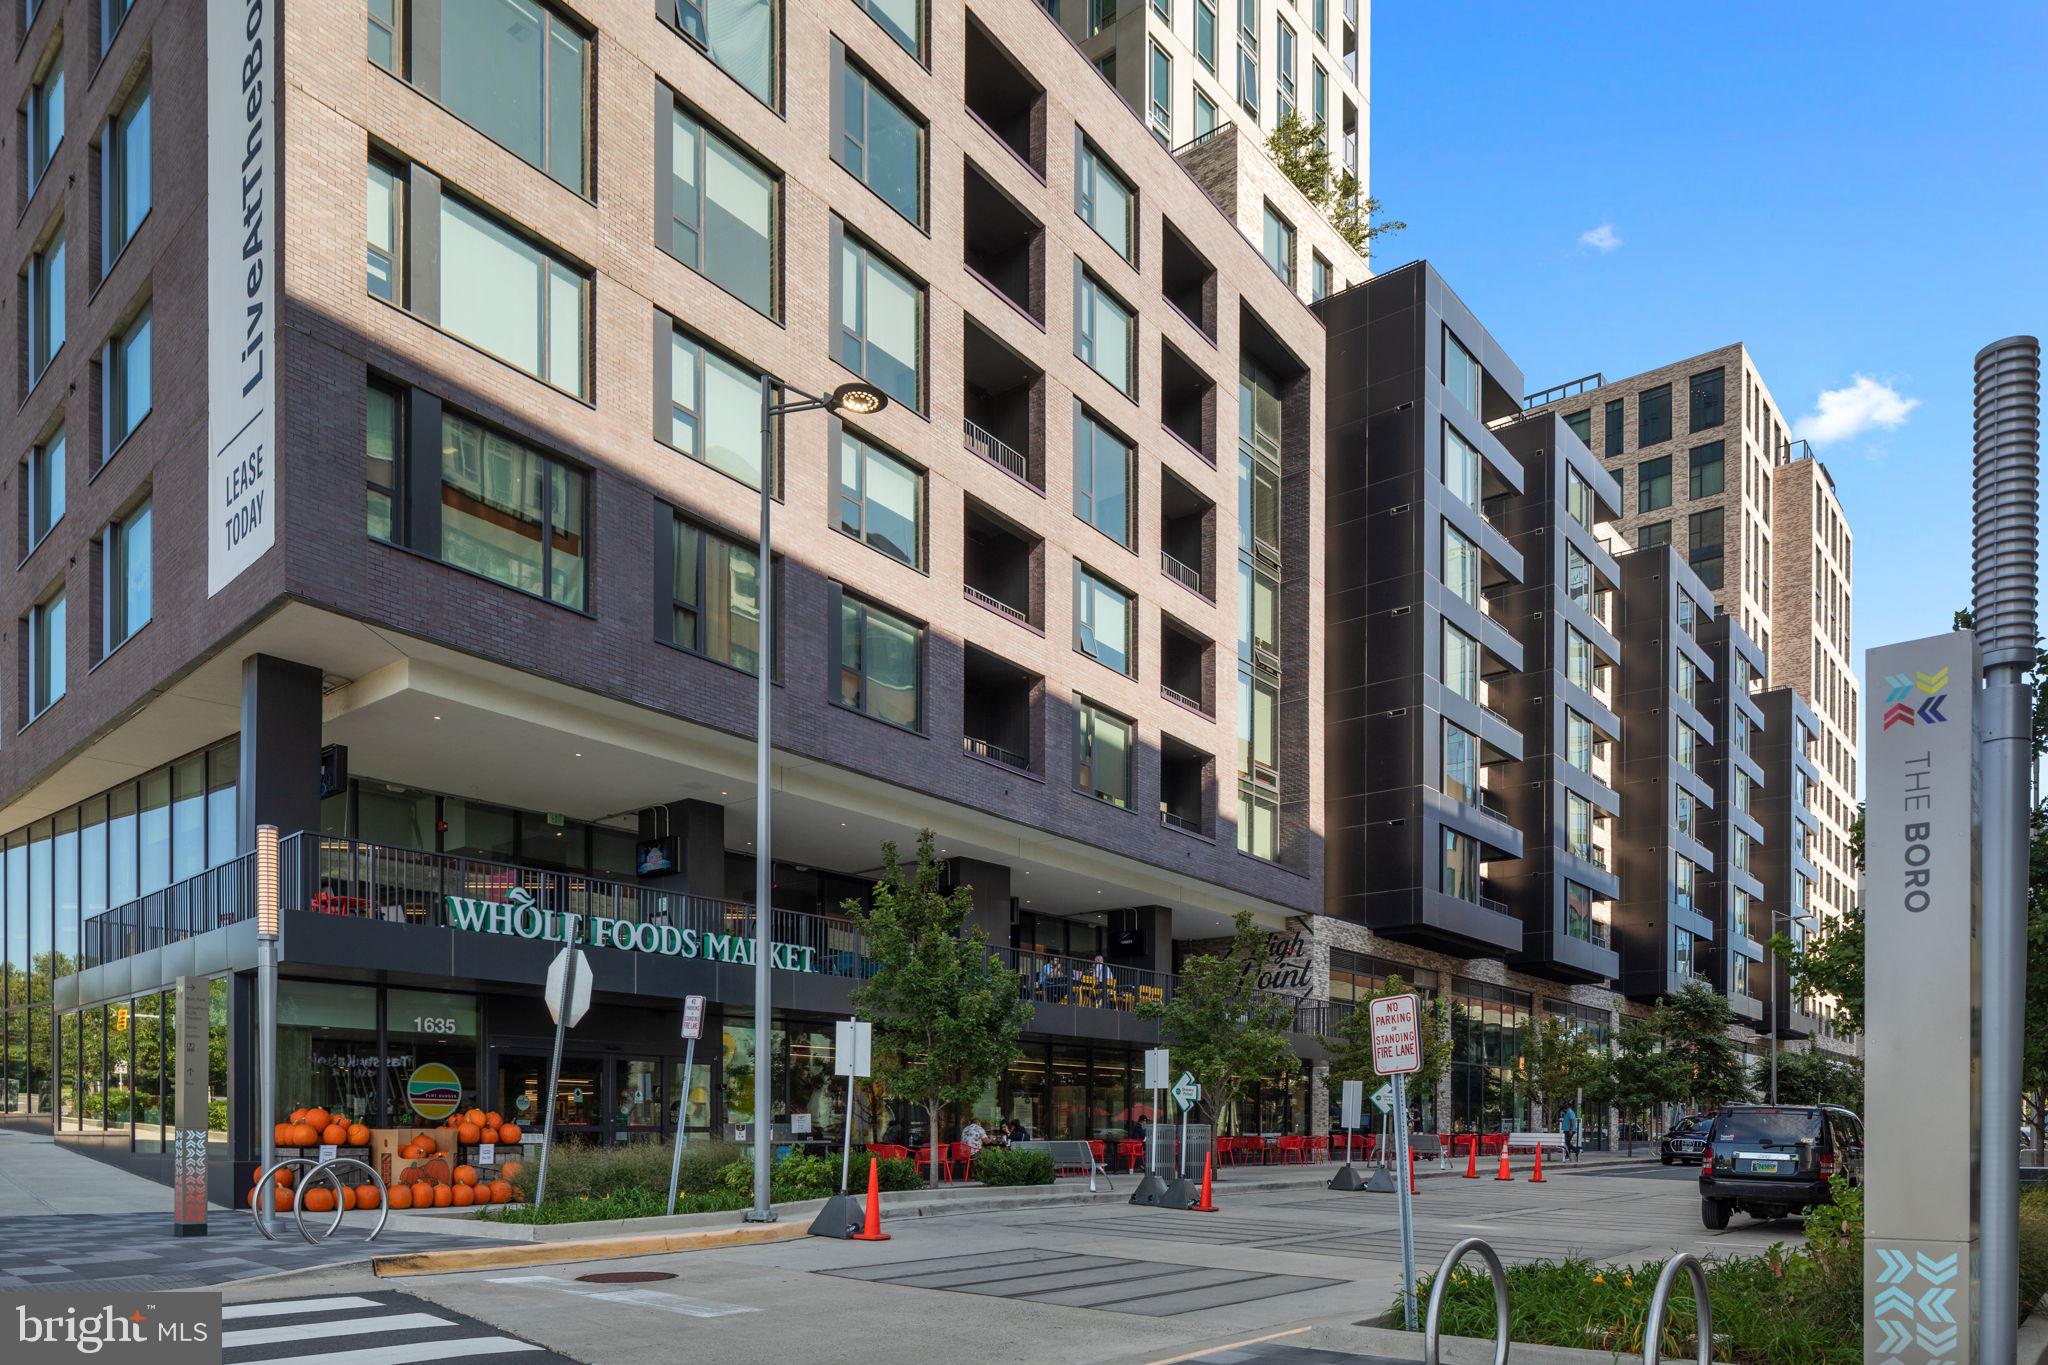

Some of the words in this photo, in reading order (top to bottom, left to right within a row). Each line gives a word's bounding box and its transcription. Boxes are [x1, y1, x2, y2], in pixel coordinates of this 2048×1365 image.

[241, 0, 263, 398] LiveAtTheBo
[226, 444, 264, 508] LEASE
[225, 489, 265, 551] TODAY
[1905, 750, 1931, 812] THE
[1904, 822, 1931, 913] BORO
[446, 887, 584, 944] WHOLE
[590, 916, 699, 959] FOODS
[1266, 931, 1305, 964] igh
[413, 1016, 456, 1034] 1635
[1375, 1012, 1412, 1027] PARKING
[1386, 1002, 1399, 1013] NO
[1375, 1031, 1415, 1046] STANDING
[1376, 1046, 1394, 1060] FIRE
[1395, 1042, 1415, 1058] LANE
